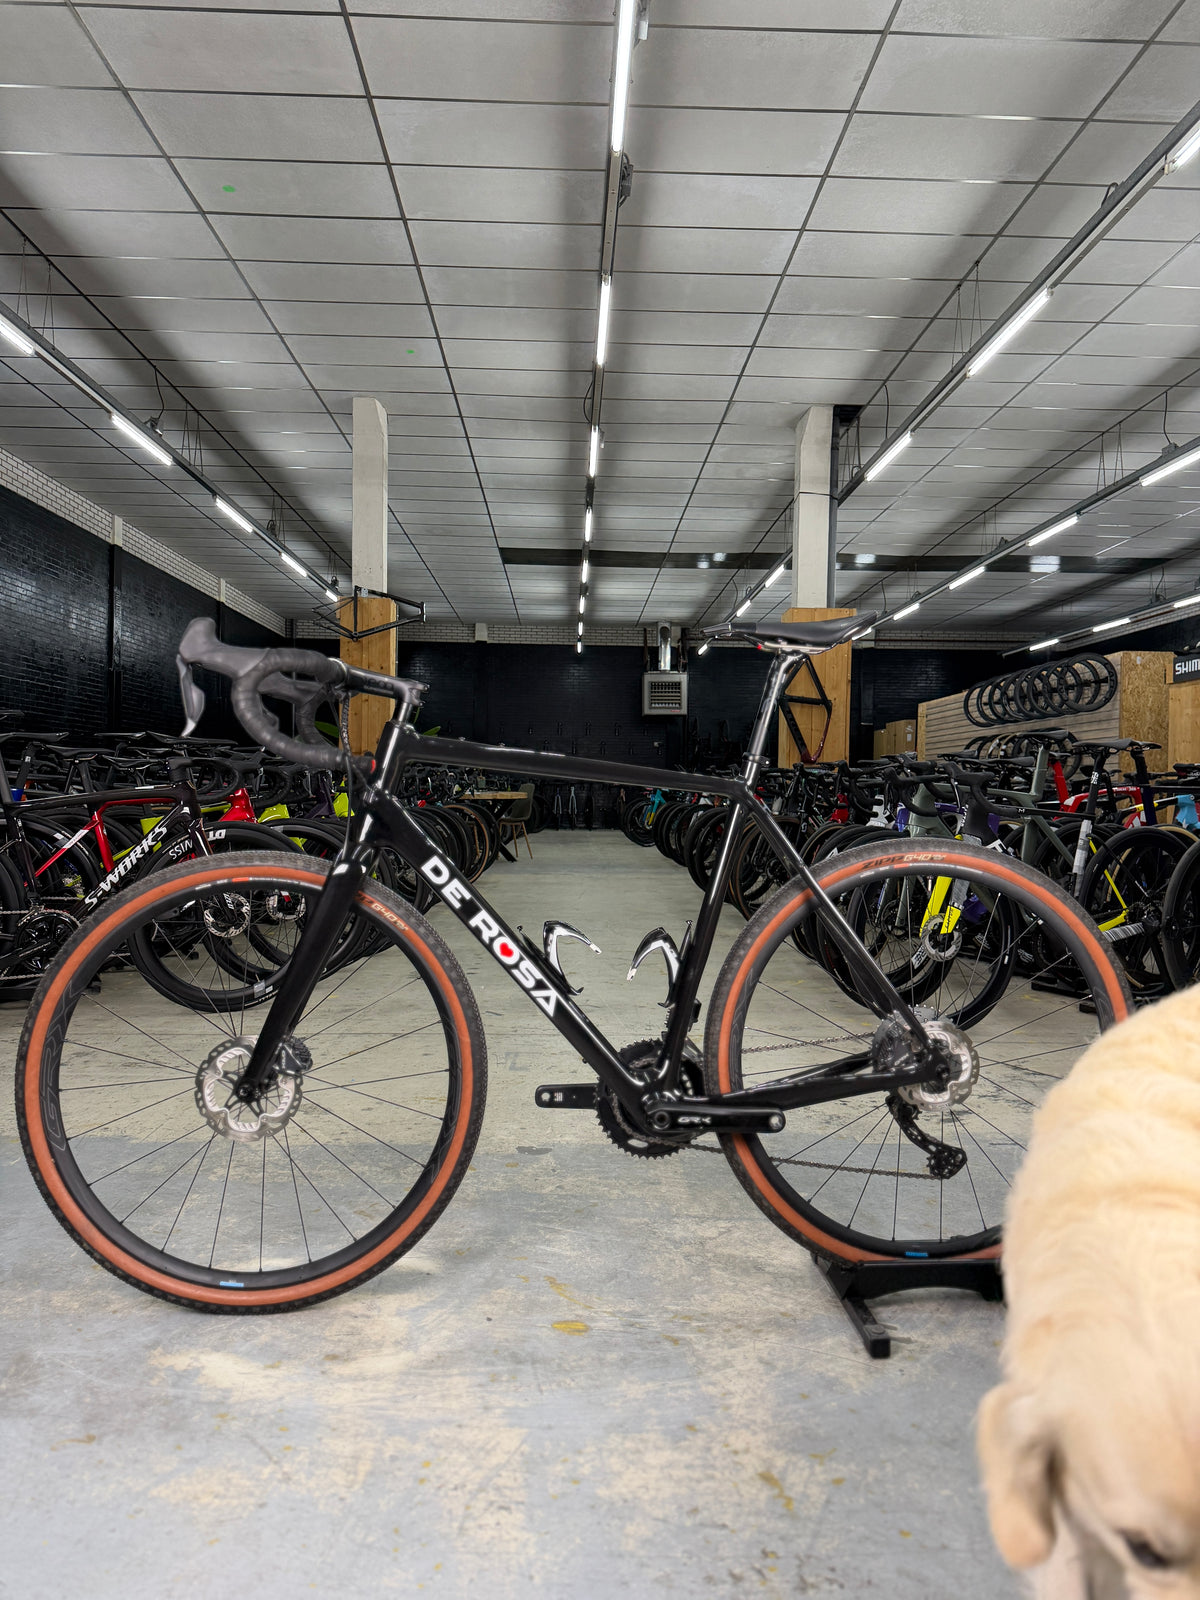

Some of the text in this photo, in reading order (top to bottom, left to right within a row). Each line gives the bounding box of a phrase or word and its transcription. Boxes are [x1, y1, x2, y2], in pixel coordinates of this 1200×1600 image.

[84, 826, 168, 911] S-WORKS
[168, 839, 193, 860] WISS
[903, 853, 931, 862] G40
[421, 855, 560, 1018] DE ROSA
